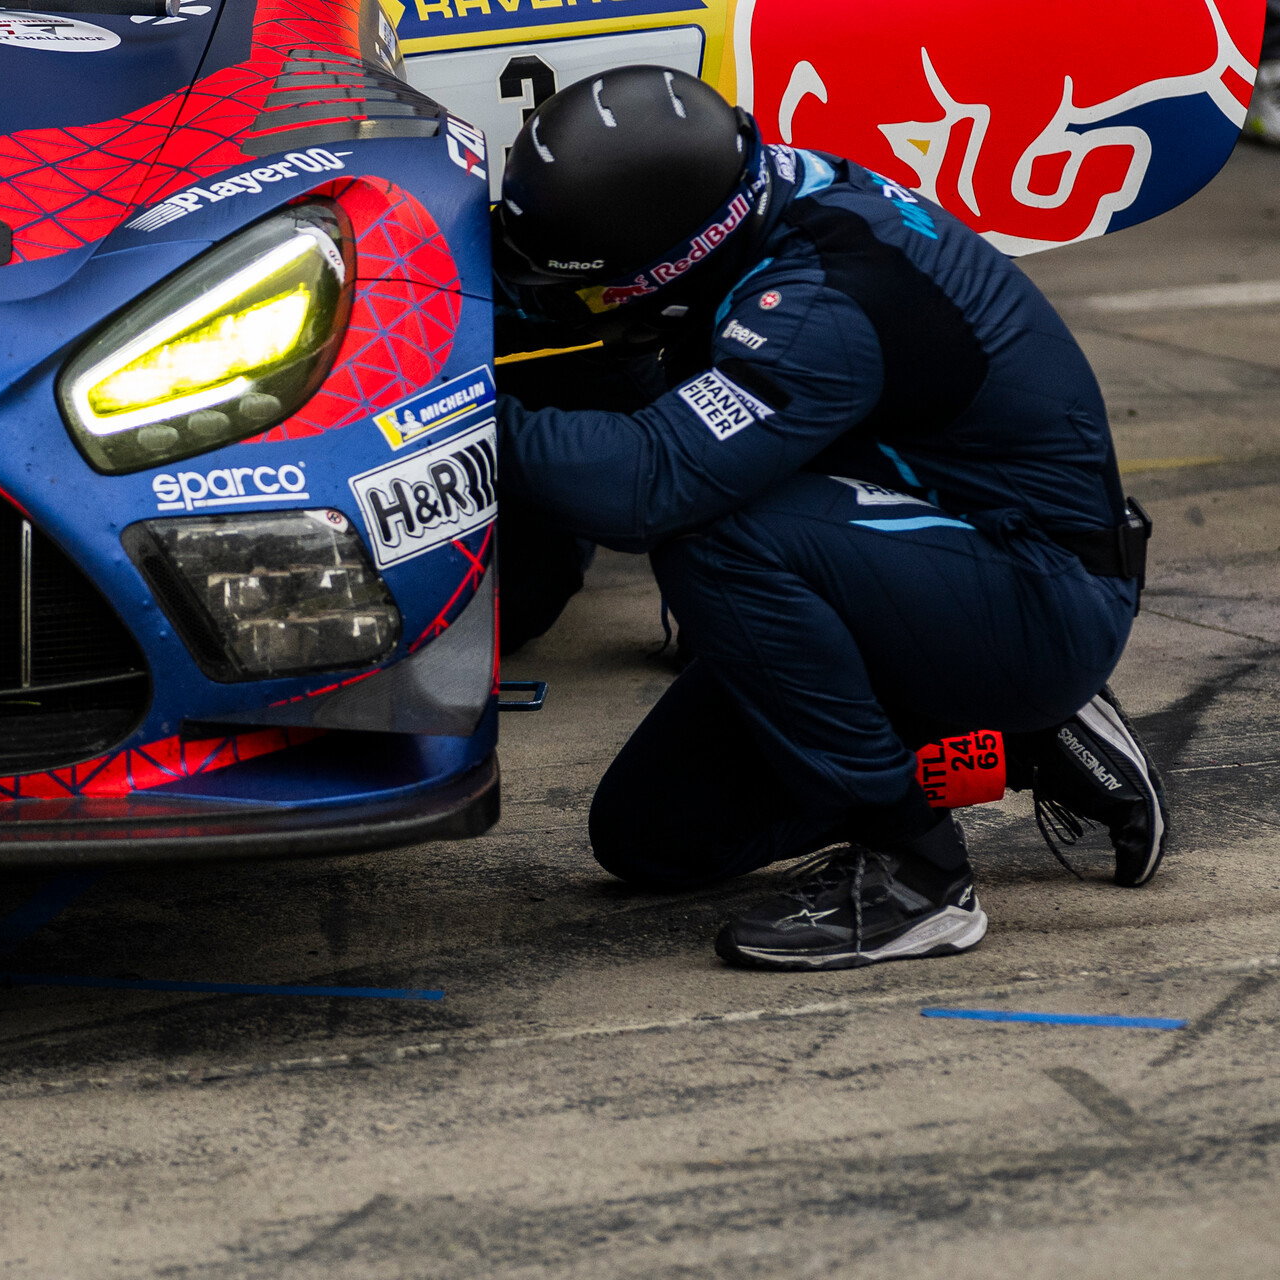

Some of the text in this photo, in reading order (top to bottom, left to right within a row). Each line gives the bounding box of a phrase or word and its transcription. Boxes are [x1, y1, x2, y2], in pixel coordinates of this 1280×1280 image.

[651, 236, 710, 285] Red
[702, 194, 751, 254] Bull
[419, 381, 486, 422] MICHELIN
[682, 383, 732, 436] FILTER
[698, 374, 753, 426] MANN
[368, 461, 470, 544] H&R
[950, 738, 974, 771] 24
[1057, 726, 1123, 792] ALPINESTARS
